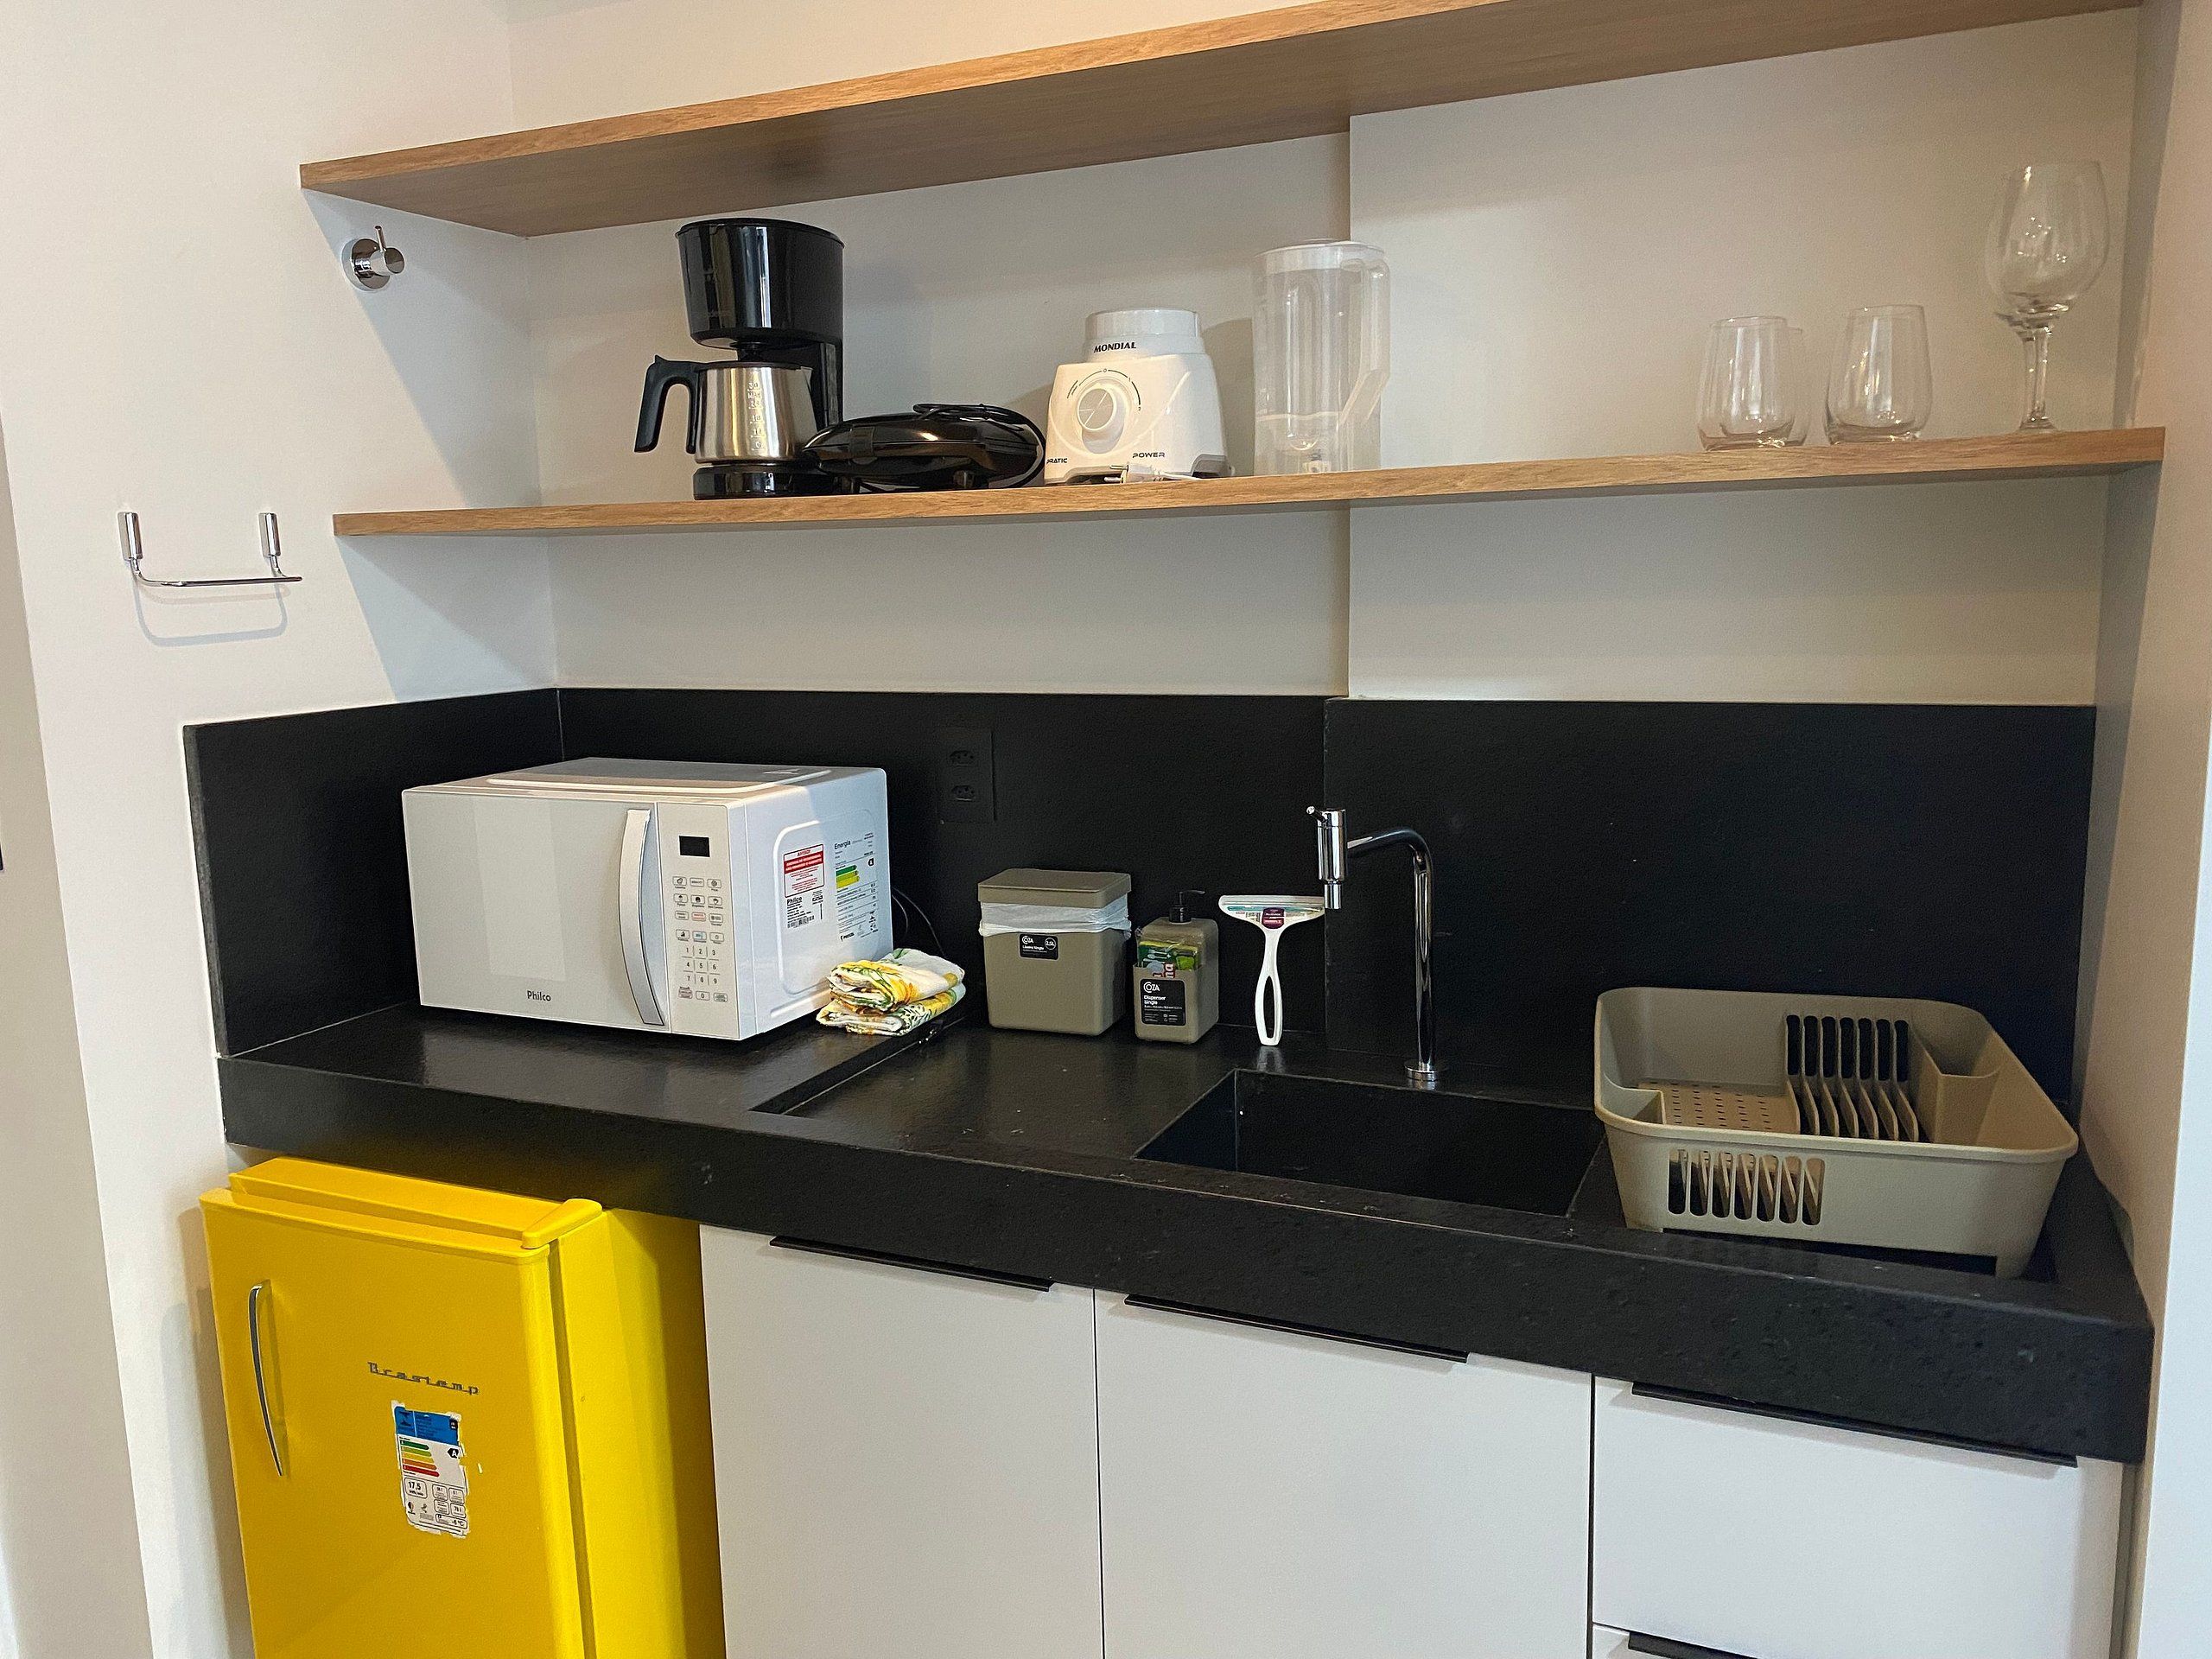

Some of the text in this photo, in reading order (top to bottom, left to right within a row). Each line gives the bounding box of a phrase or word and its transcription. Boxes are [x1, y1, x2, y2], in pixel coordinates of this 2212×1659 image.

[1093, 341, 1137, 353] MONDIAL
[835, 841, 850, 849] Energia
[1143, 981, 1160, 993] COZA
[526, 989, 552, 1002] Philco
[367, 1362, 479, 1395] Brastemp
[408, 1481, 422, 1491] 17,5
